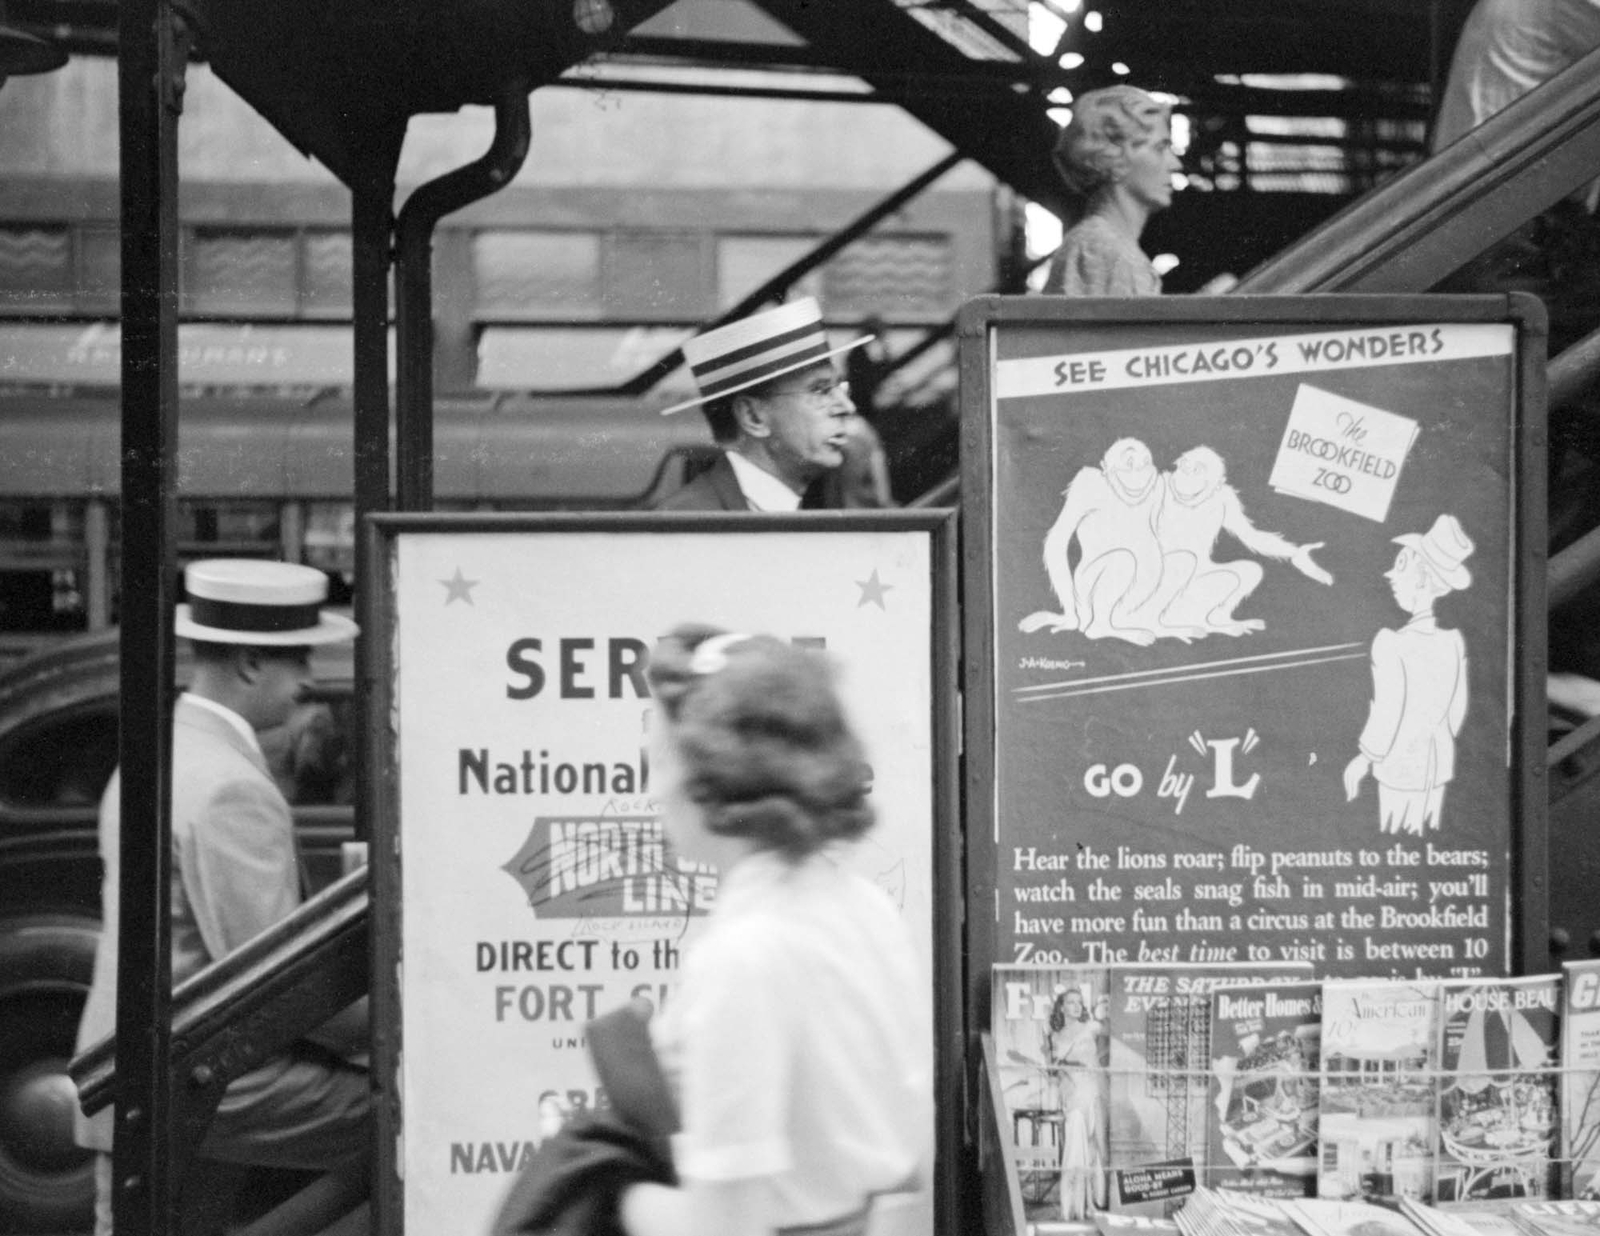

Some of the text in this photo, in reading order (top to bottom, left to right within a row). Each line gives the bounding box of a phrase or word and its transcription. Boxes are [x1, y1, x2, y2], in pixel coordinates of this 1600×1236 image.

[1053, 328, 1443, 386] SEE CHICAGO'S WONDERS
[1336, 411, 1368, 447] The
[1286, 429, 1397, 480] BROOKFIELD
[1312, 467, 1352, 494] ZOO
[1083, 763, 1143, 798] GO
[1156, 754, 1194, 815] by
[550, 822, 663, 898] NORTH
[1013, 843, 1489, 876] Hear the lions roar; flip peanuts to the bears;
[1013, 873, 1488, 907] watch the seals snag fish in mid-air; you'll
[1014, 904, 1488, 935] have more fun than a circus at the Brookfield
[476, 938, 679, 972] DIRECT to th
[1013, 936, 1489, 964] Zoo. The best time to visit is between 10
[1123, 975, 1170, 993] THE
[495, 983, 604, 1022] FORT
[1218, 995, 1264, 1019] Better
[1265, 992, 1311, 1018] Homes
[1350, 997, 1427, 1020] American
[1445, 990, 1510, 1012] HOUSE
[450, 1141, 535, 1174] NAVA
